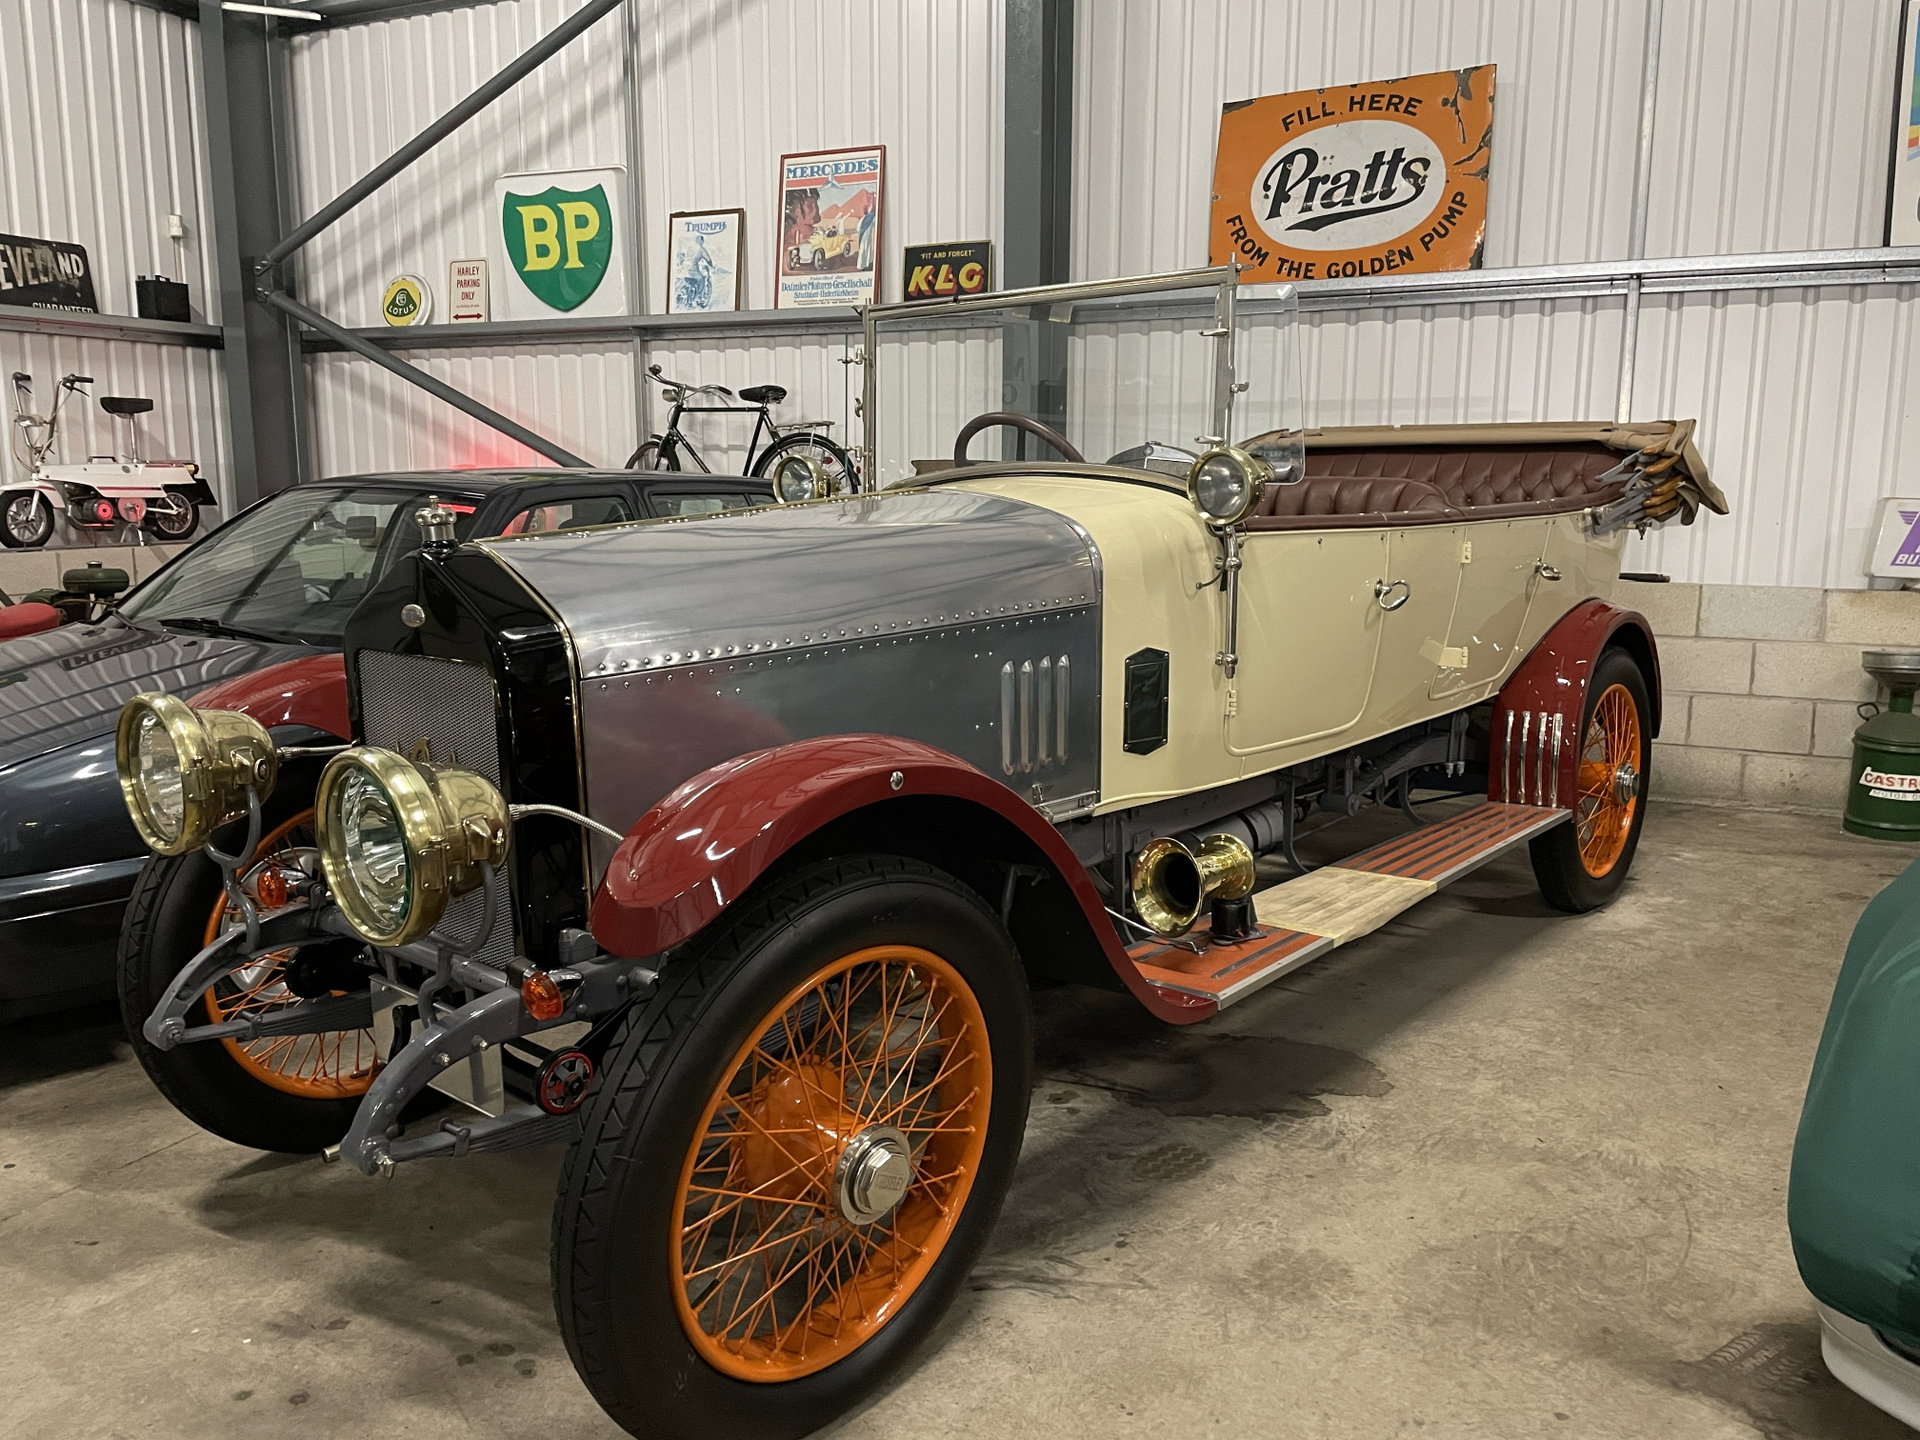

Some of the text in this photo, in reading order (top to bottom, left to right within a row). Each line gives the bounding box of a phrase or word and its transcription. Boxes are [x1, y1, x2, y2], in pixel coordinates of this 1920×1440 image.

[1281, 94, 1423, 132] FILL HERE
[786, 159, 879, 179] MERCEDES
[1263, 147, 1431, 231] Pratts
[685, 221, 727, 234] TRIUMPH
[515, 201, 600, 271] BP
[1226, 190, 1469, 280] FROM THE GOLDEN PUMP
[933, 251, 946, 259] AND
[457, 266, 480, 276] HARLEY
[456, 279, 480, 288] PARKING
[461, 291, 475, 301] ONLY
[388, 304, 414, 316] LOTUS
[1864, 772, 1920, 788] CASTR
